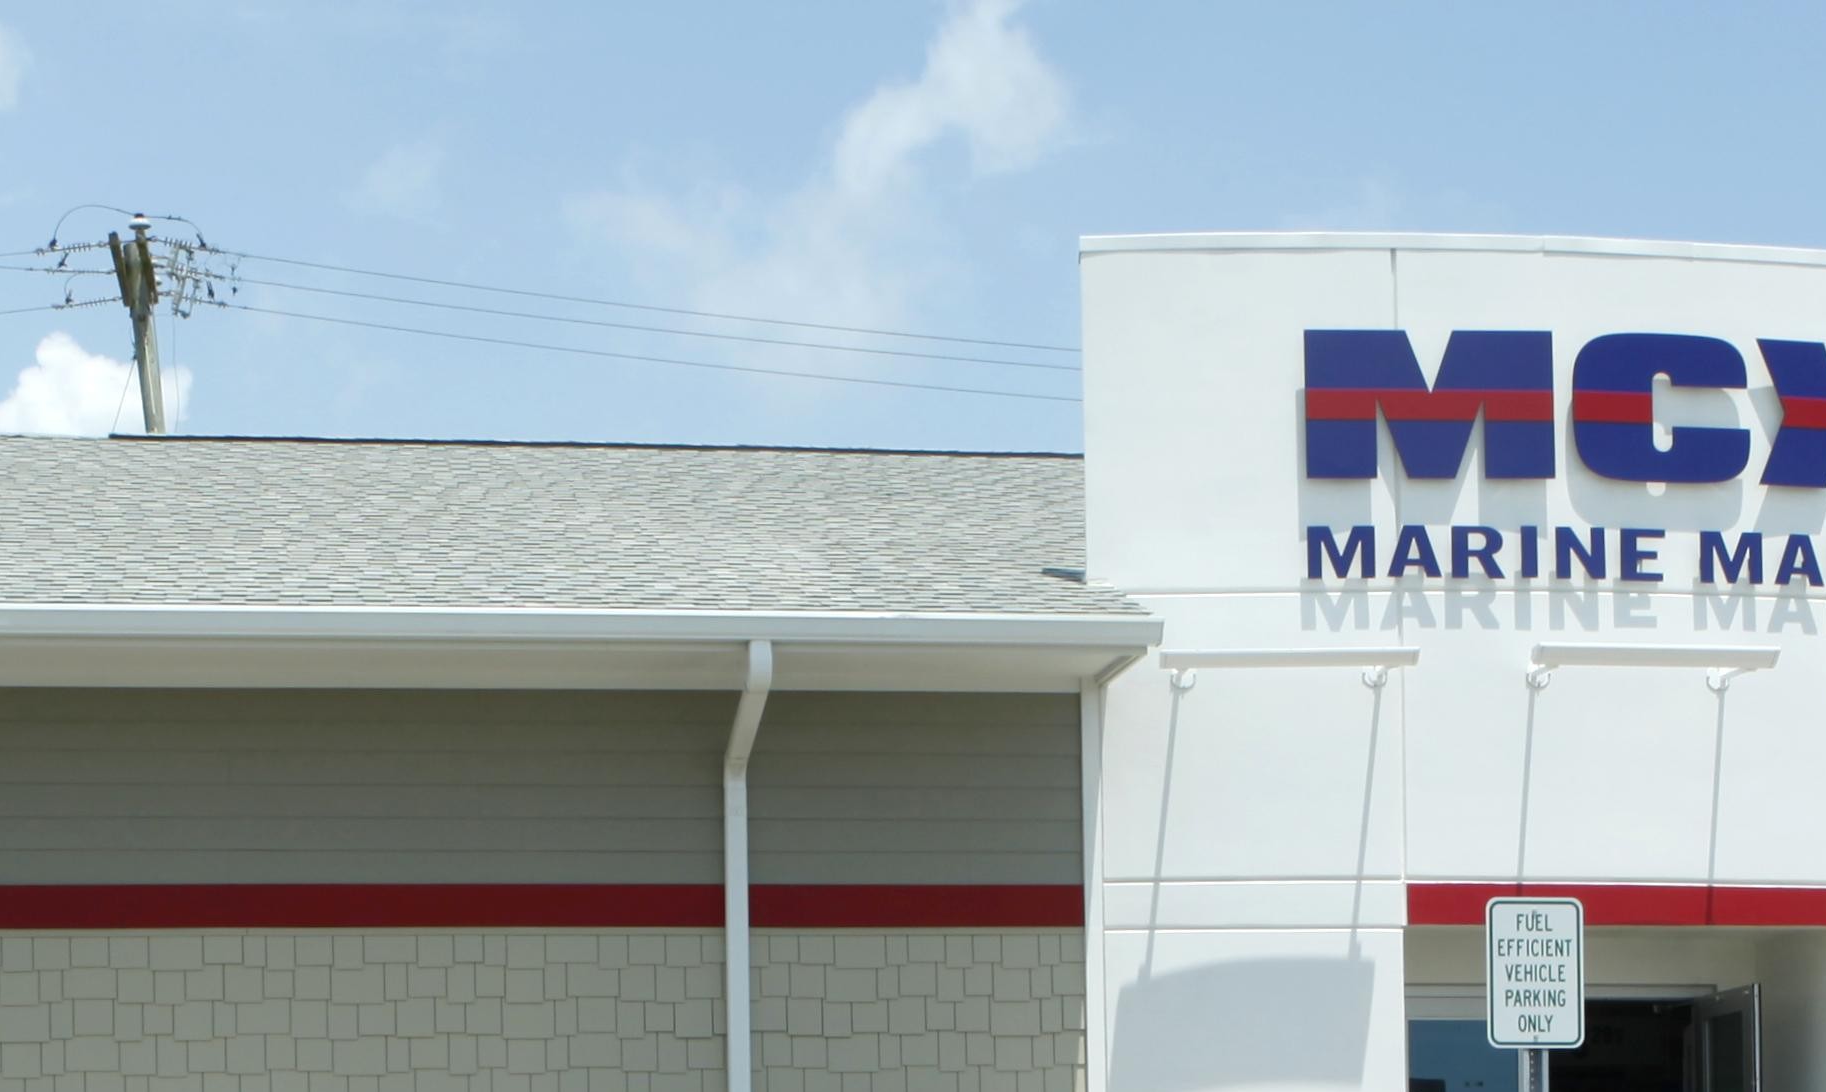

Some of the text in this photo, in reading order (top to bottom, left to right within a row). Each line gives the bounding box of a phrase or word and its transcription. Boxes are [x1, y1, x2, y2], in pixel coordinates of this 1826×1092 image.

[1307, 525, 1665, 582] MARINE
[1516, 914, 1553, 931] FUEL
[1498, 939, 1572, 957] EFFICIENT
[1505, 964, 1566, 982] VEHICLE
[1505, 990, 1566, 1007] PARKING
[1518, 1015, 1553, 1032] ONLY
